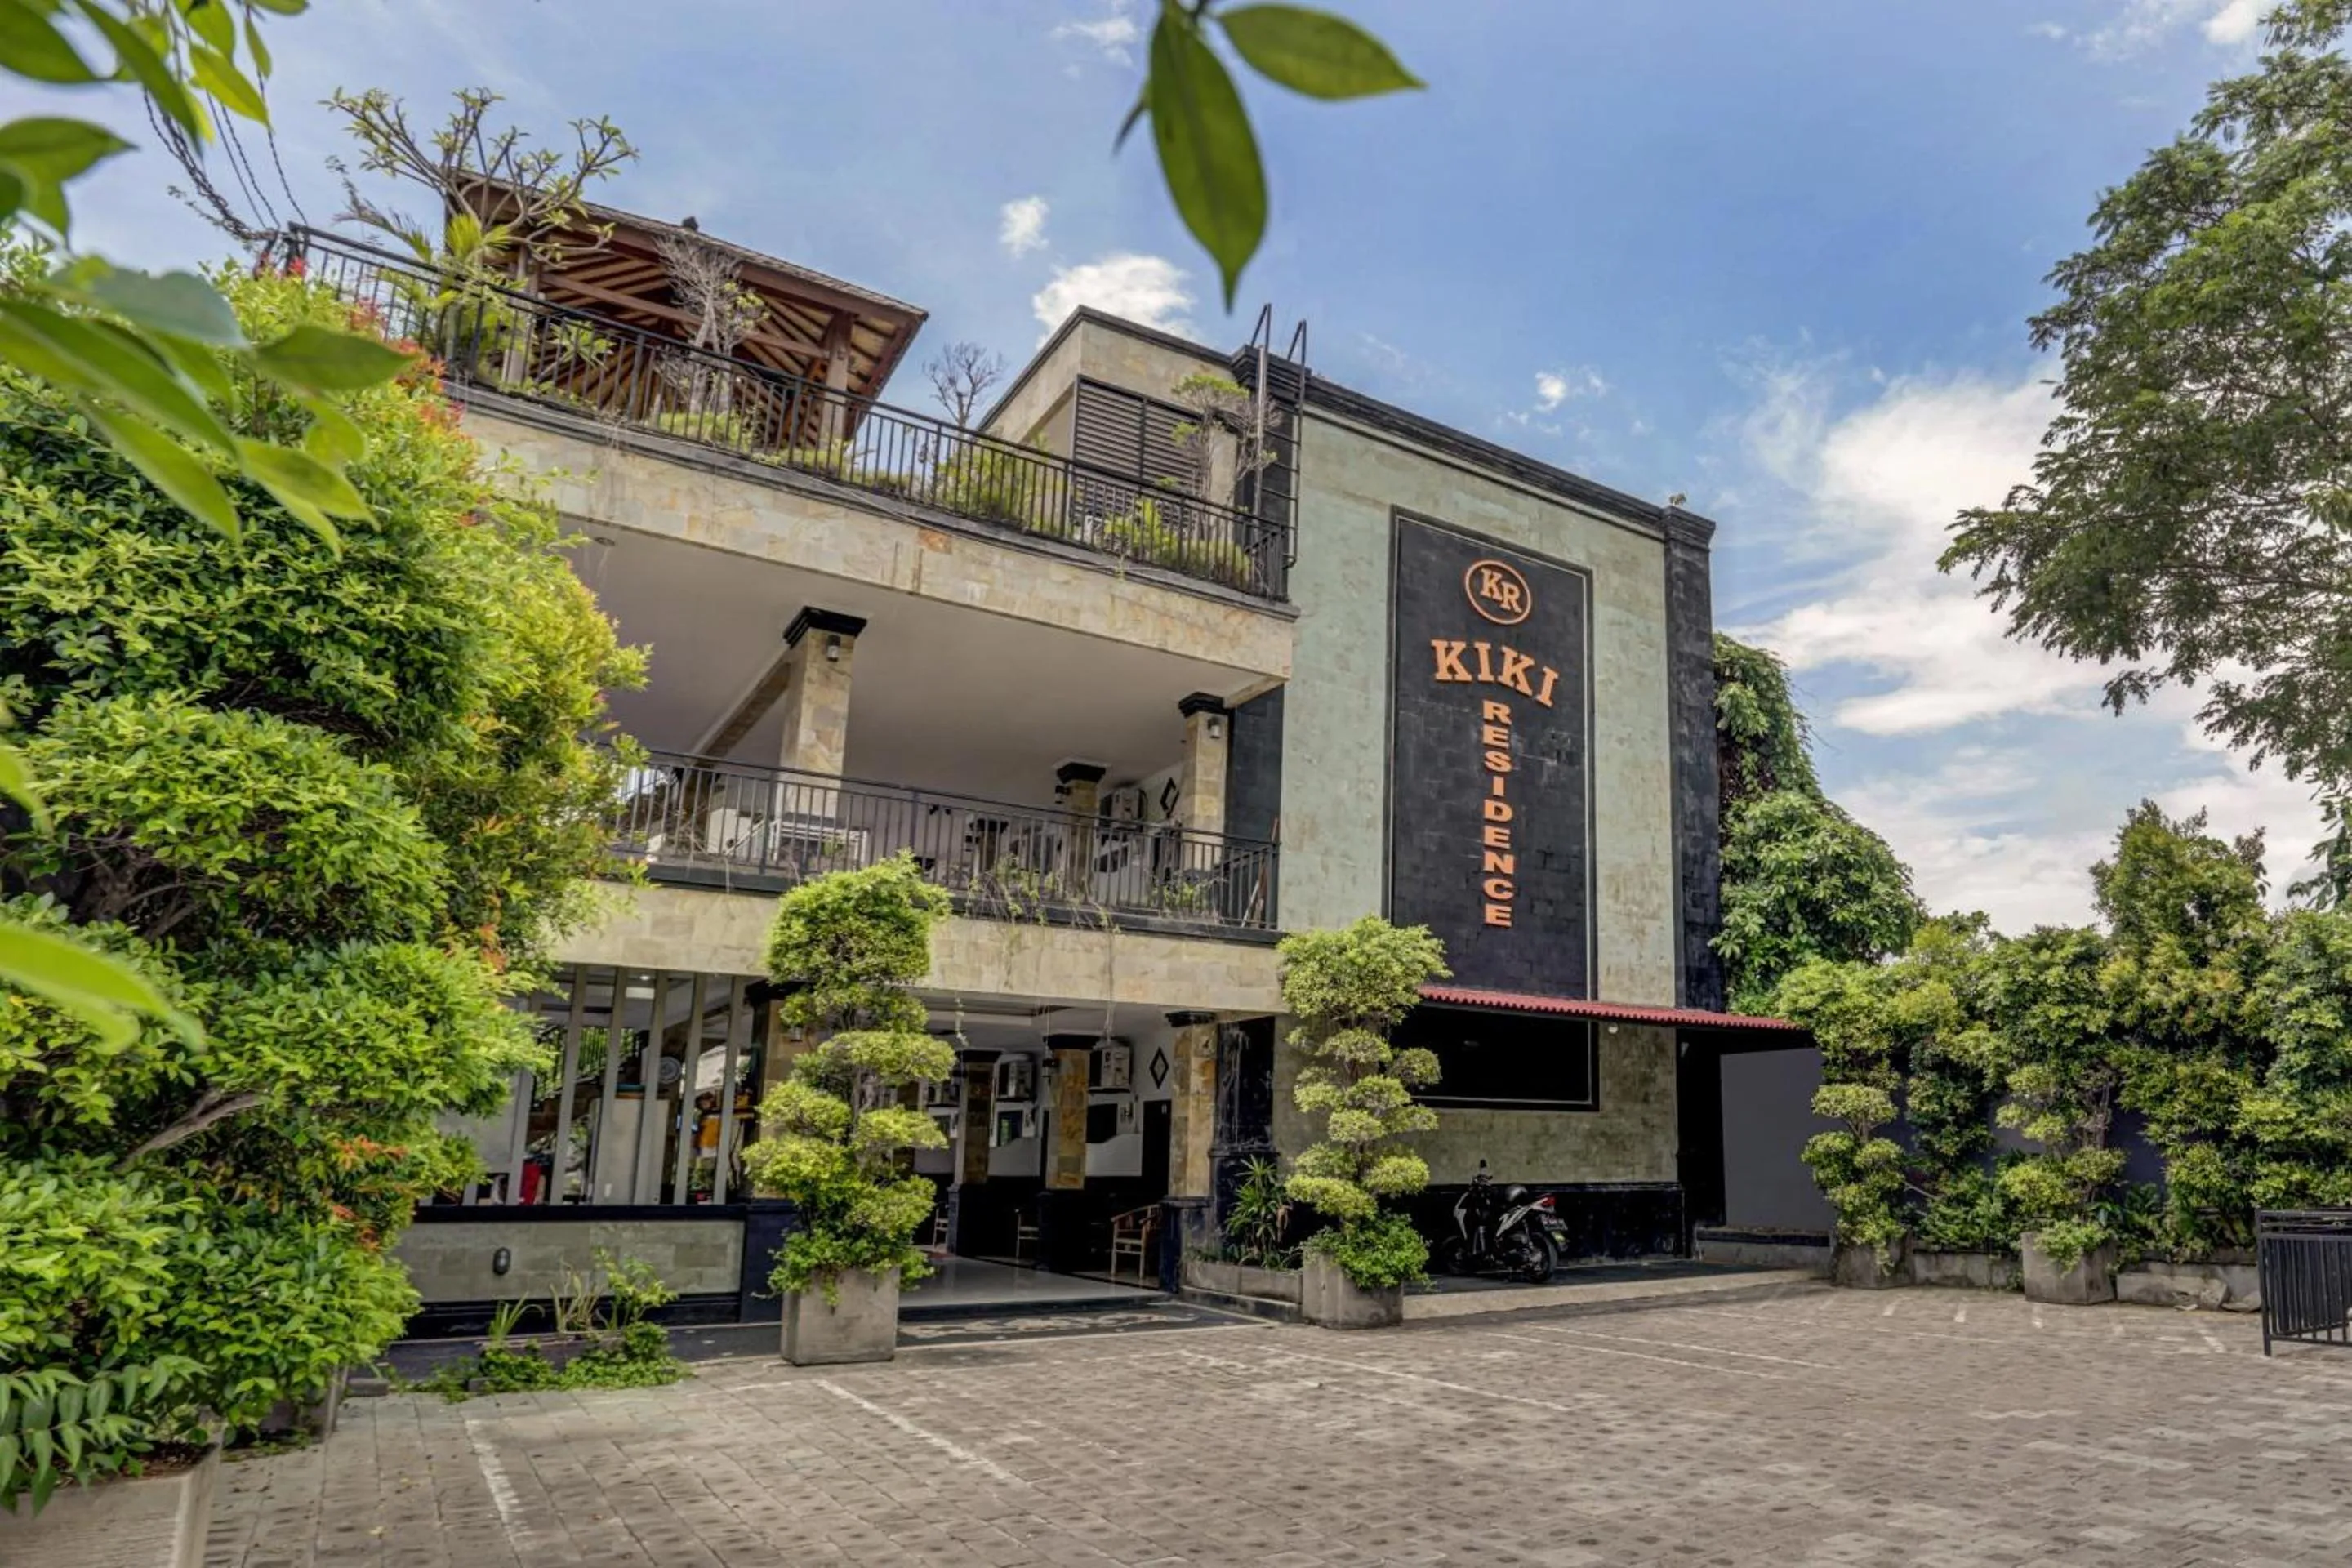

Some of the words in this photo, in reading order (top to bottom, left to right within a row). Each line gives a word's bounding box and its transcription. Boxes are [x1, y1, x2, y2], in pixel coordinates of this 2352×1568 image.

[1480, 568, 1523, 613] KR
[1431, 639, 1559, 707] KIKI
[1482, 700, 1515, 927] RESIDENCE
